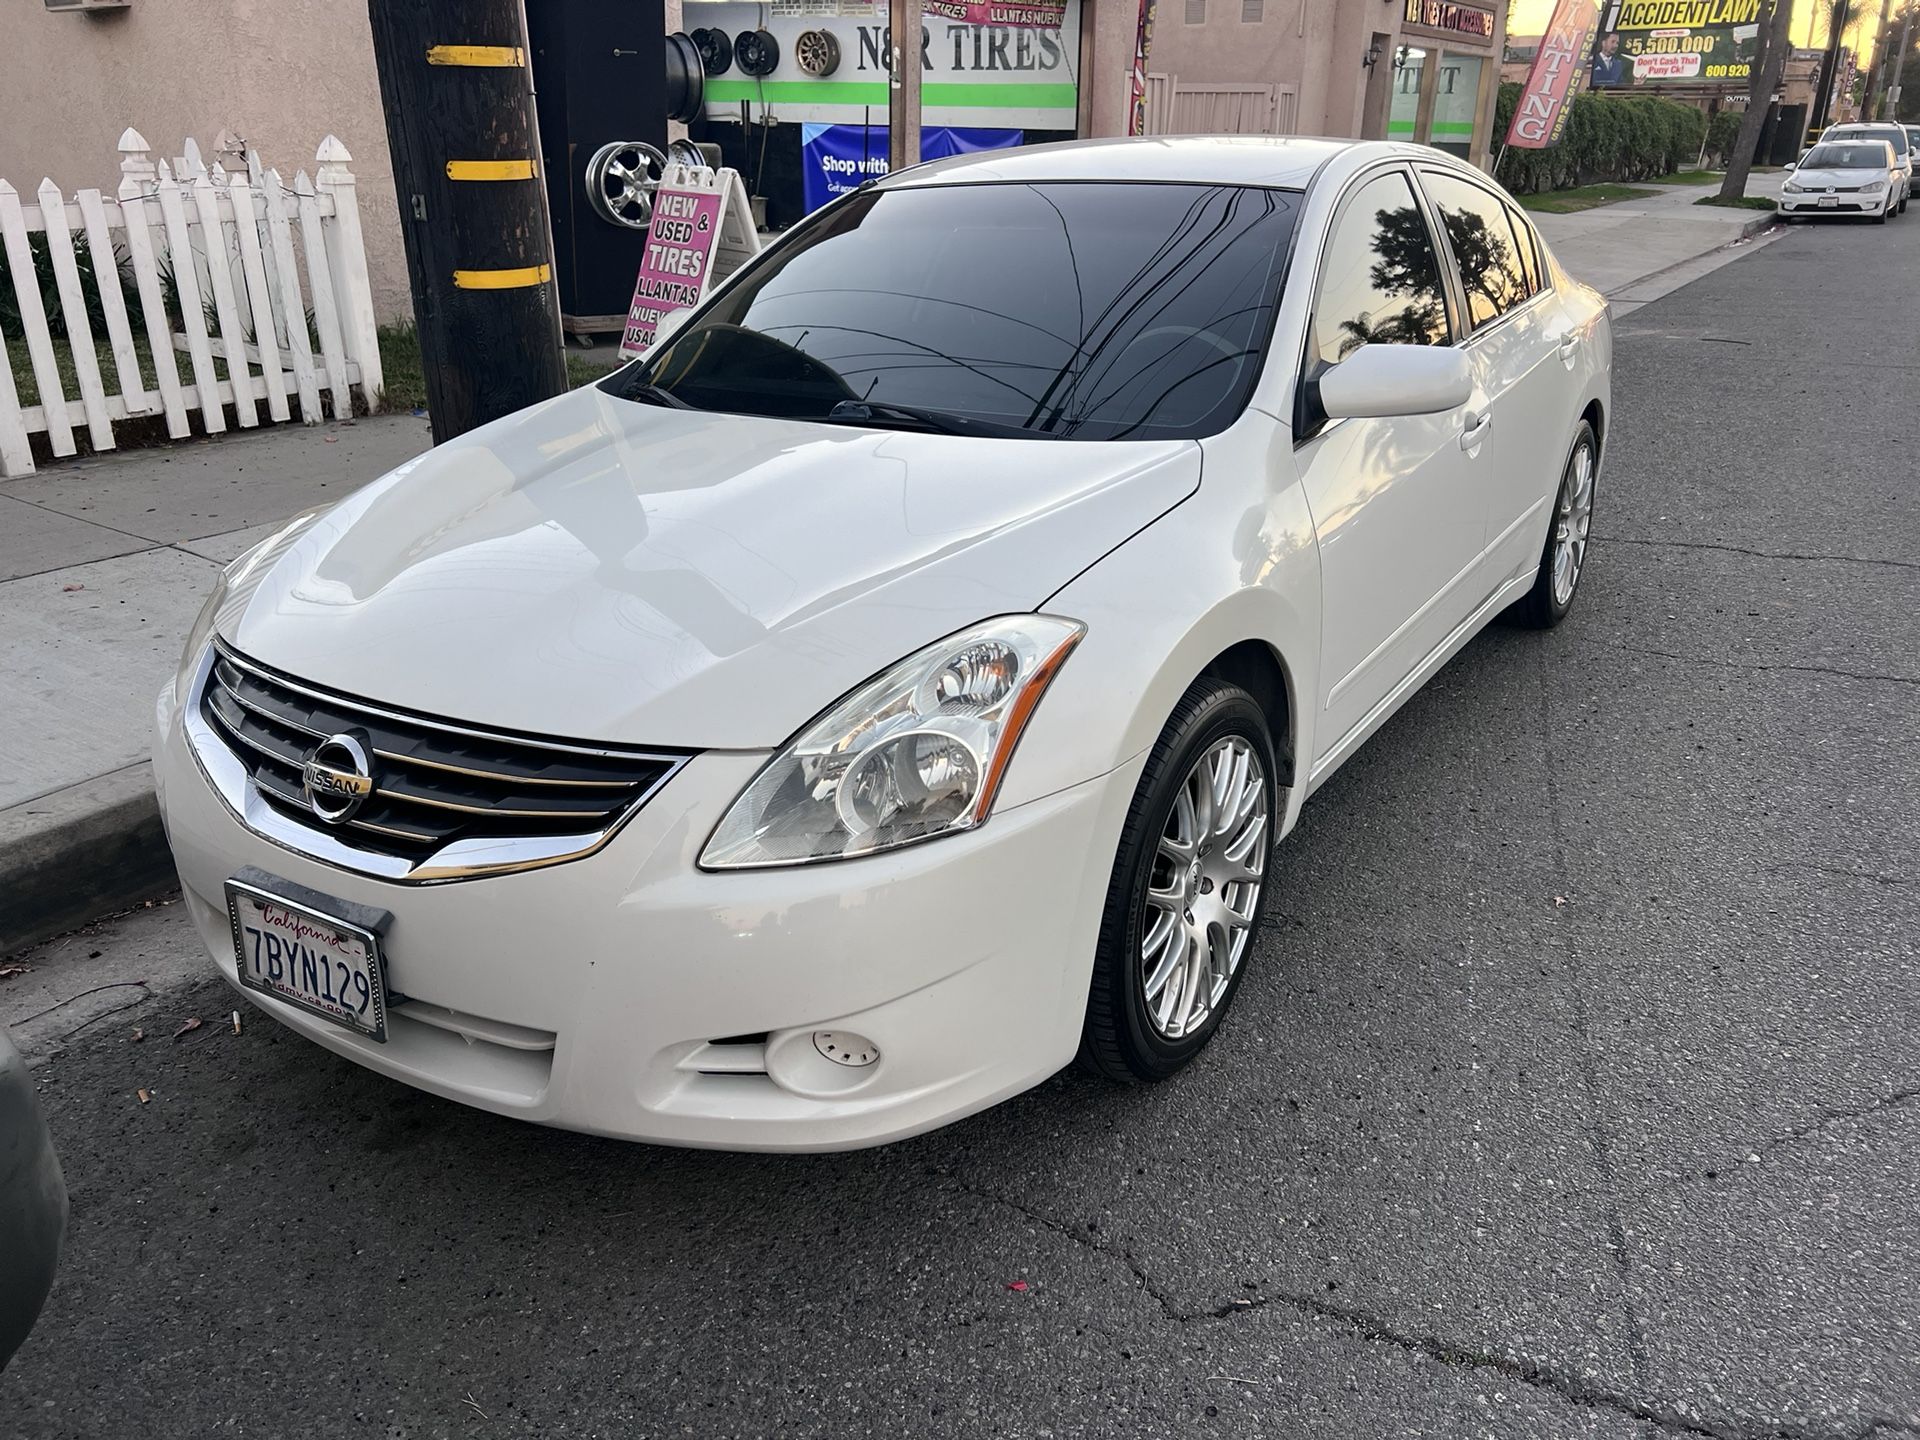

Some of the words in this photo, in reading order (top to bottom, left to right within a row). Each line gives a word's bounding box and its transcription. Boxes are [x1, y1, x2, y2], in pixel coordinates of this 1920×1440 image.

[933, 2, 968, 19] TIRES
[990, 8, 1033, 24] LLANTAS
[1618, 0, 1710, 26] ACCIDENT
[1708, 0, 1777, 24] LAWY
[947, 24, 1061, 71] TIRES
[1579, 23, 1599, 61] HOME
[1637, 57, 1657, 66] Don't
[1660, 57, 1678, 65] Cash
[1681, 56, 1698, 64] That
[1648, 66, 1669, 75] Puny
[1706, 65, 1727, 77] 800
[1551, 68, 1583, 141] BUSINESS
[823, 155, 855, 176] Shop
[858, 157, 888, 174] with
[658, 194, 699, 219] NEW
[654, 219, 693, 243] USED
[697, 213, 708, 231] &
[649, 244, 703, 278] TIRES
[637, 278, 698, 306] LLANTAS
[304, 766, 360, 795] NISSAN
[263, 905, 350, 955] California
[245, 926, 370, 1015] 7BYN129
